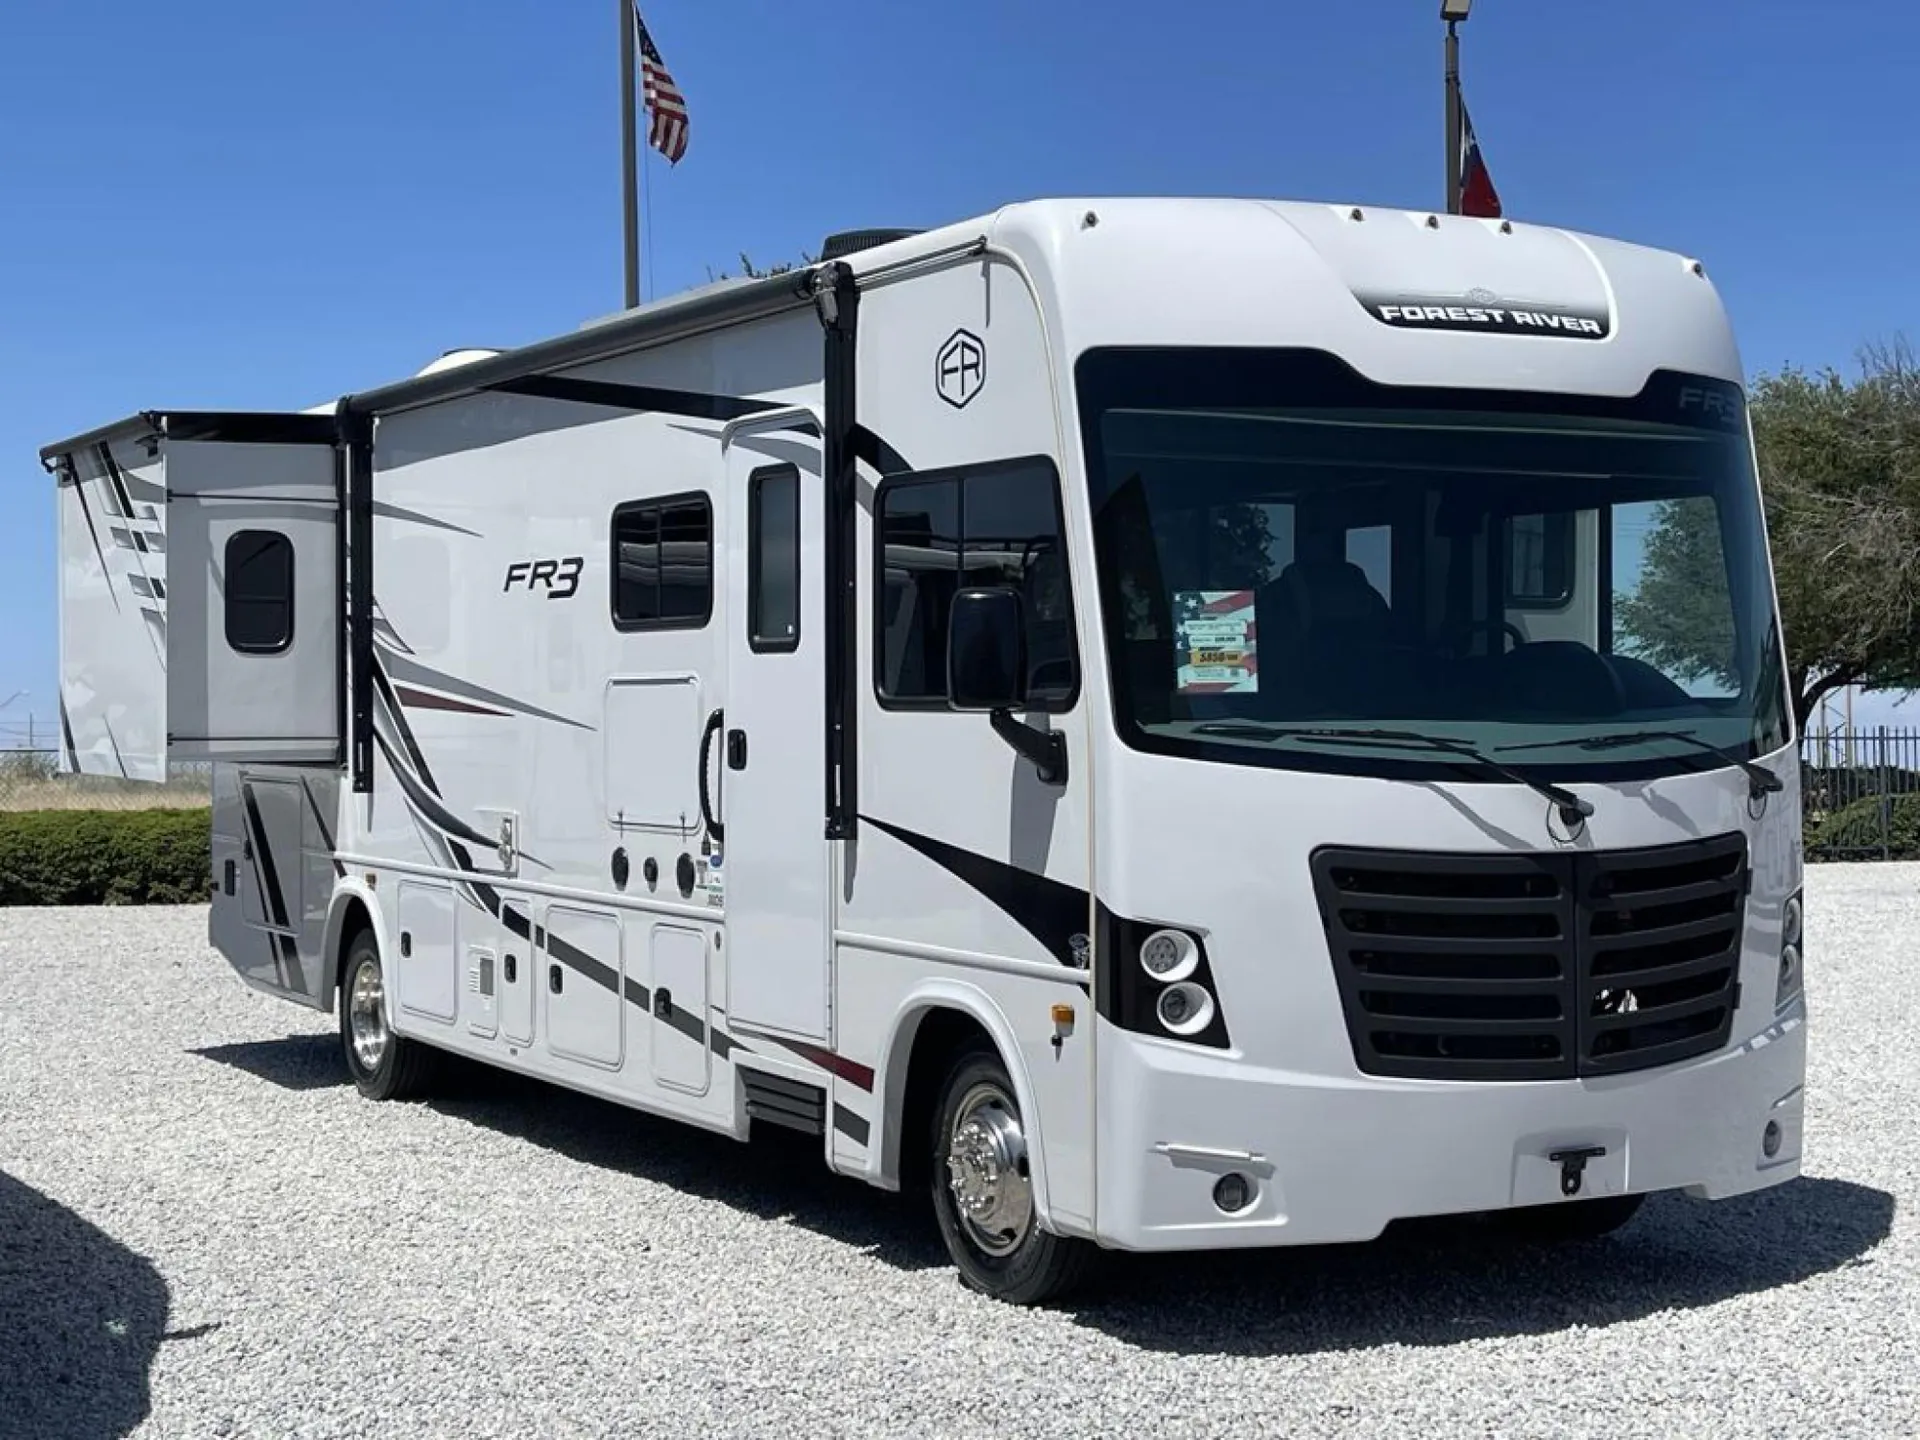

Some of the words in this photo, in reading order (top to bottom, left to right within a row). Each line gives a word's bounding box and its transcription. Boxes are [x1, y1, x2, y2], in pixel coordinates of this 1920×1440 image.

[1377, 304, 1505, 323] FOREST
[1511, 310, 1602, 335] RIVER
[940, 339, 981, 397] FR
[503, 556, 584, 599] FR3
